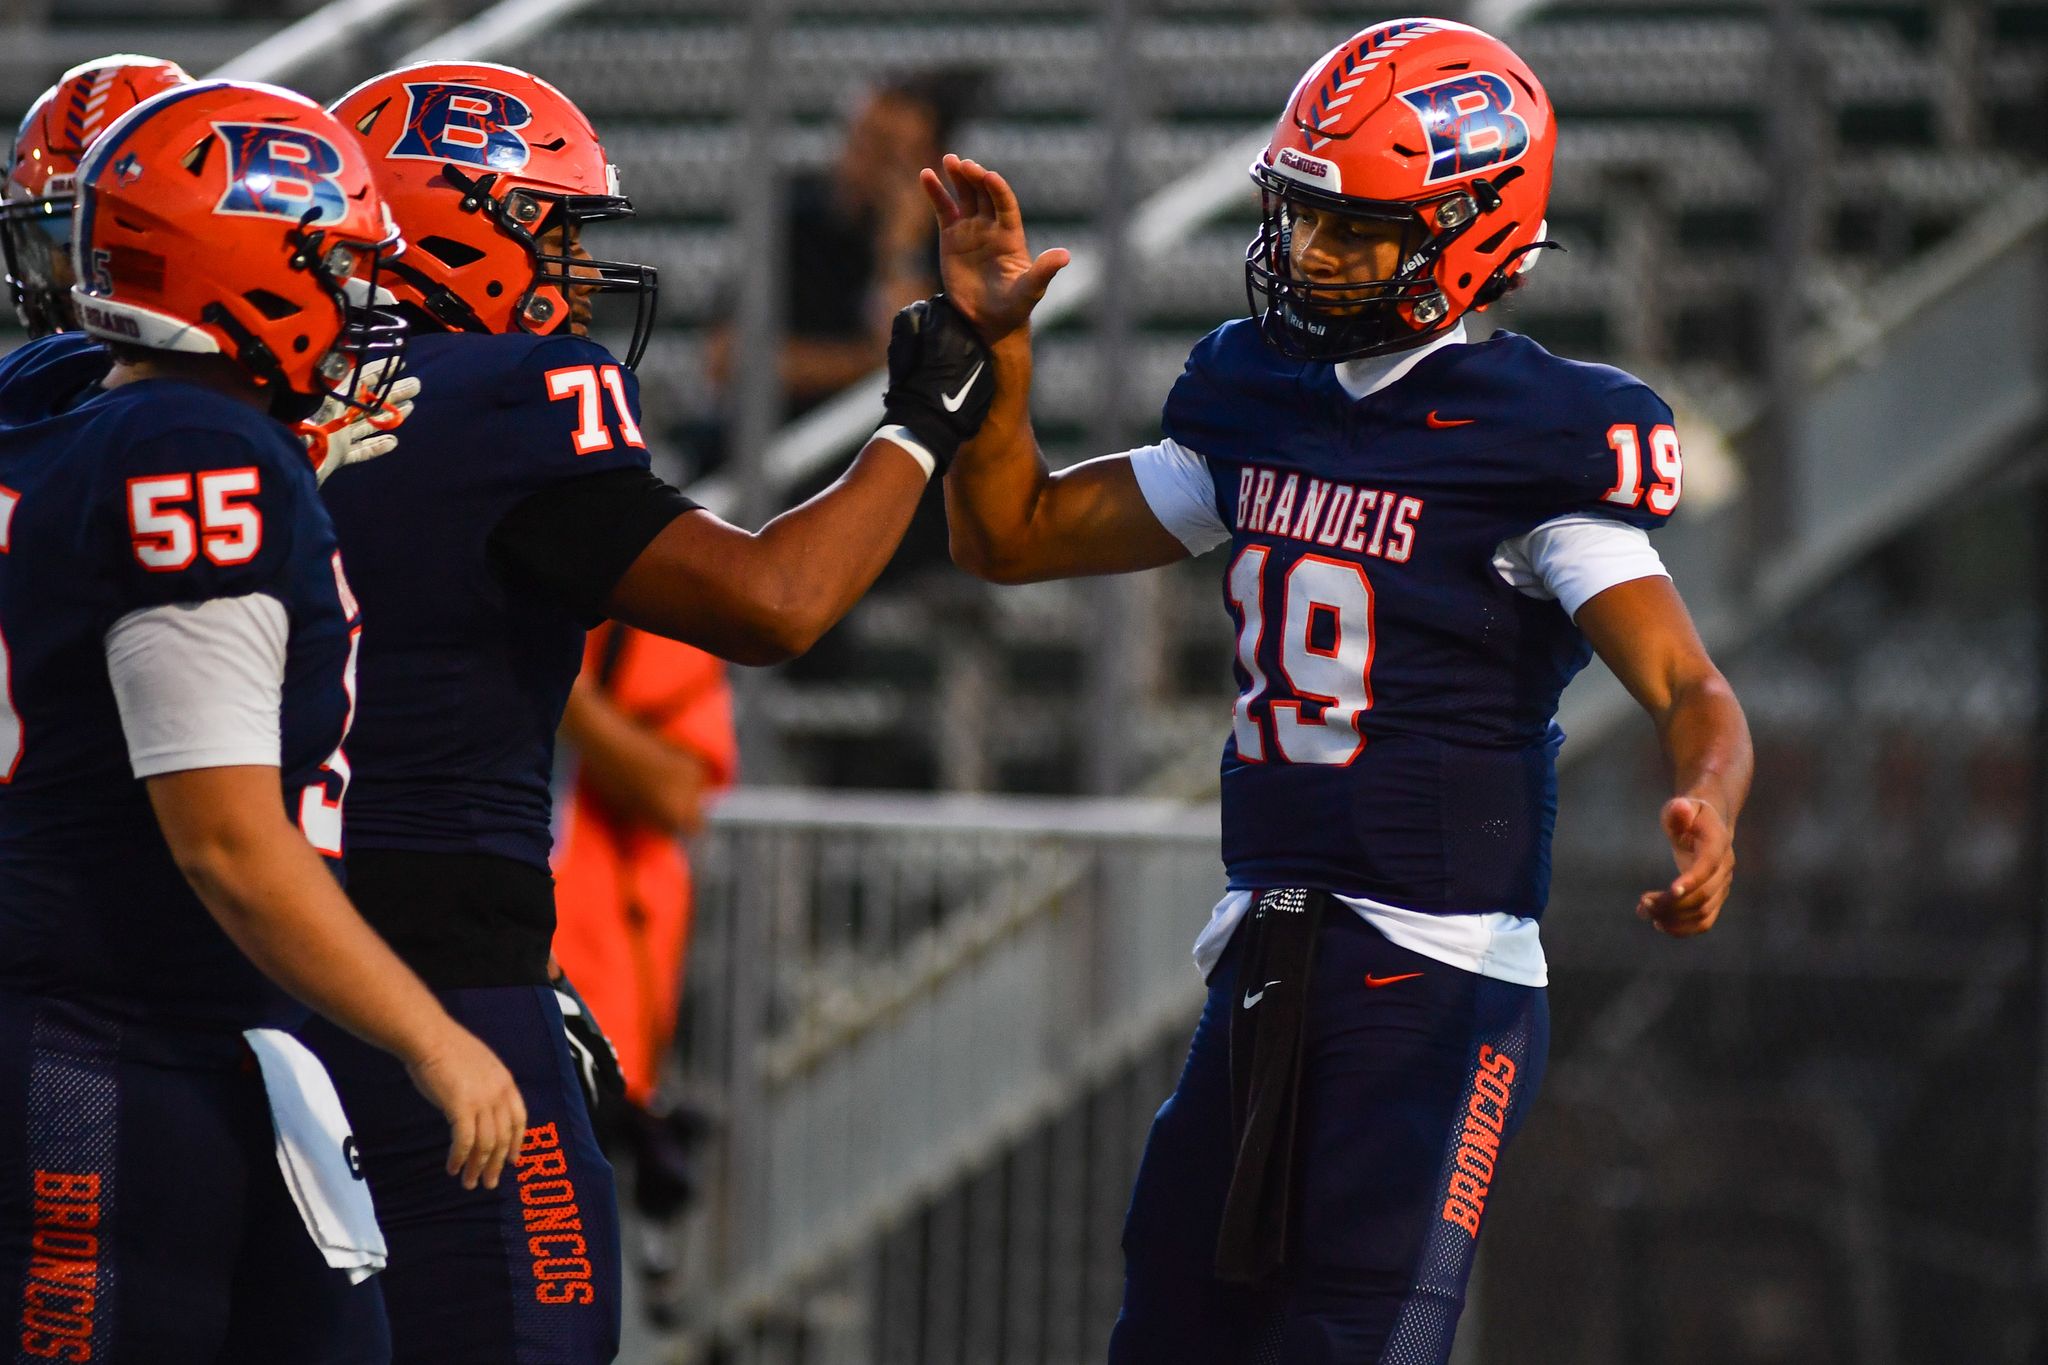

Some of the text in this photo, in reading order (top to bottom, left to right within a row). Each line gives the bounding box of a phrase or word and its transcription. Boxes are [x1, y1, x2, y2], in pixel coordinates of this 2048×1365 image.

[211, 121, 350, 227] B
[386, 81, 533, 173] B
[1396, 71, 1531, 186] B
[544, 364, 647, 456] 71
[126, 466, 263, 573] 55
[1236, 466, 1424, 564] BRANDEIS
[1604, 423, 1684, 516] 19
[1226, 544, 1376, 768] 19
[1443, 1043, 1517, 1239] BRONCOS
[22, 1169, 102, 1363] BRONCOS
[514, 1121, 595, 1305] BRONCOS
